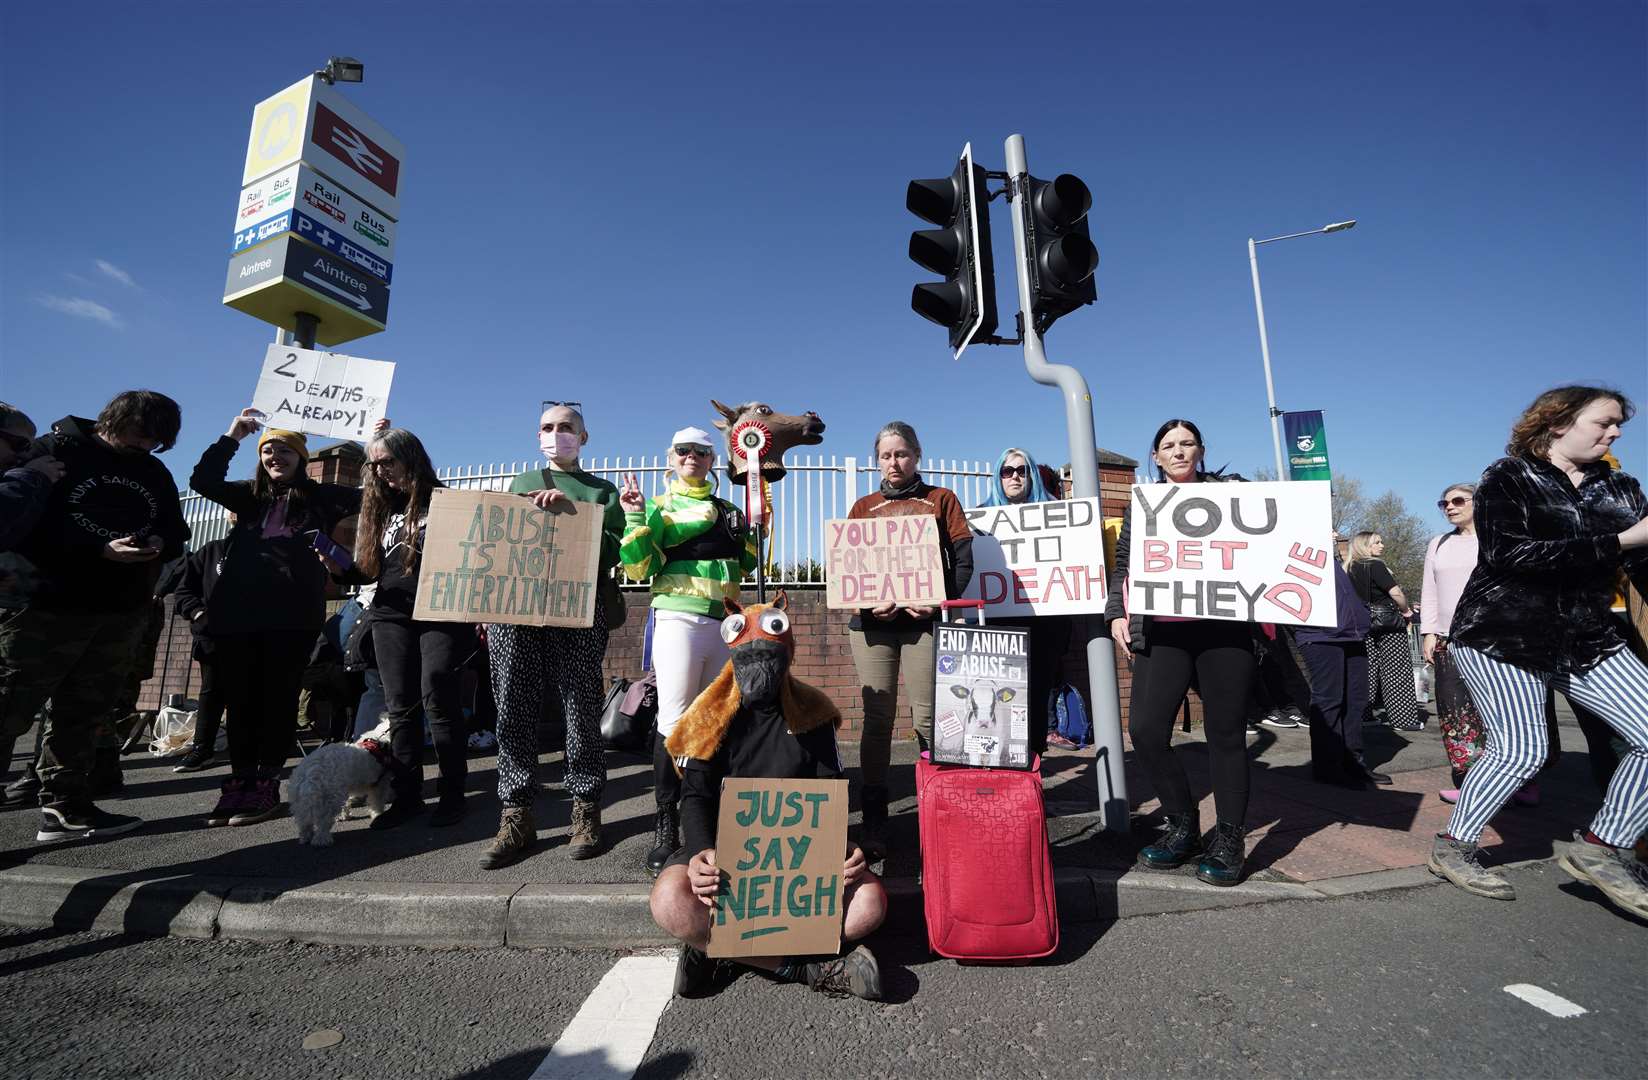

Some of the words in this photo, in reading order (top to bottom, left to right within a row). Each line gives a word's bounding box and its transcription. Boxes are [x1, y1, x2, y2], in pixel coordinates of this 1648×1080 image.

[247, 189, 261, 203] Rail
[273, 177, 290, 191] Bus
[314, 182, 340, 205] Rail
[360, 211, 385, 233] Bus
[240, 258, 272, 279] Aintree
[313, 258, 368, 293] Aintree
[273, 353, 298, 378] 2
[295, 380, 364, 403] DEATHS
[275, 398, 367, 436] ALREADY!
[68, 478, 97, 504] HUNT
[467, 503, 559, 548] ABUSE
[964, 500, 1093, 537] RACED
[1133, 485, 1278, 538] YOU
[832, 521, 877, 548] YOU
[886, 518, 928, 545] PAY
[1000, 535, 1062, 564] TO
[456, 541, 497, 574] IS
[508, 547, 565, 579] NOT
[829, 547, 868, 575] FOR
[873, 543, 940, 573] THEIR
[1143, 539, 1249, 573] BET
[429, 571, 593, 618] ENTERTAINMENT
[841, 571, 934, 602] DEATH
[979, 564, 1106, 605] DEATH
[1133, 580, 1268, 623] THEY
[1263, 541, 1328, 623] DIE
[939, 630, 967, 652] END
[971, 632, 1028, 656] ANIMAL
[959, 654, 1007, 678] ABUSE
[735, 790, 829, 829] JUST
[736, 834, 812, 871] SAY
[715, 873, 838, 926] NEIGH
